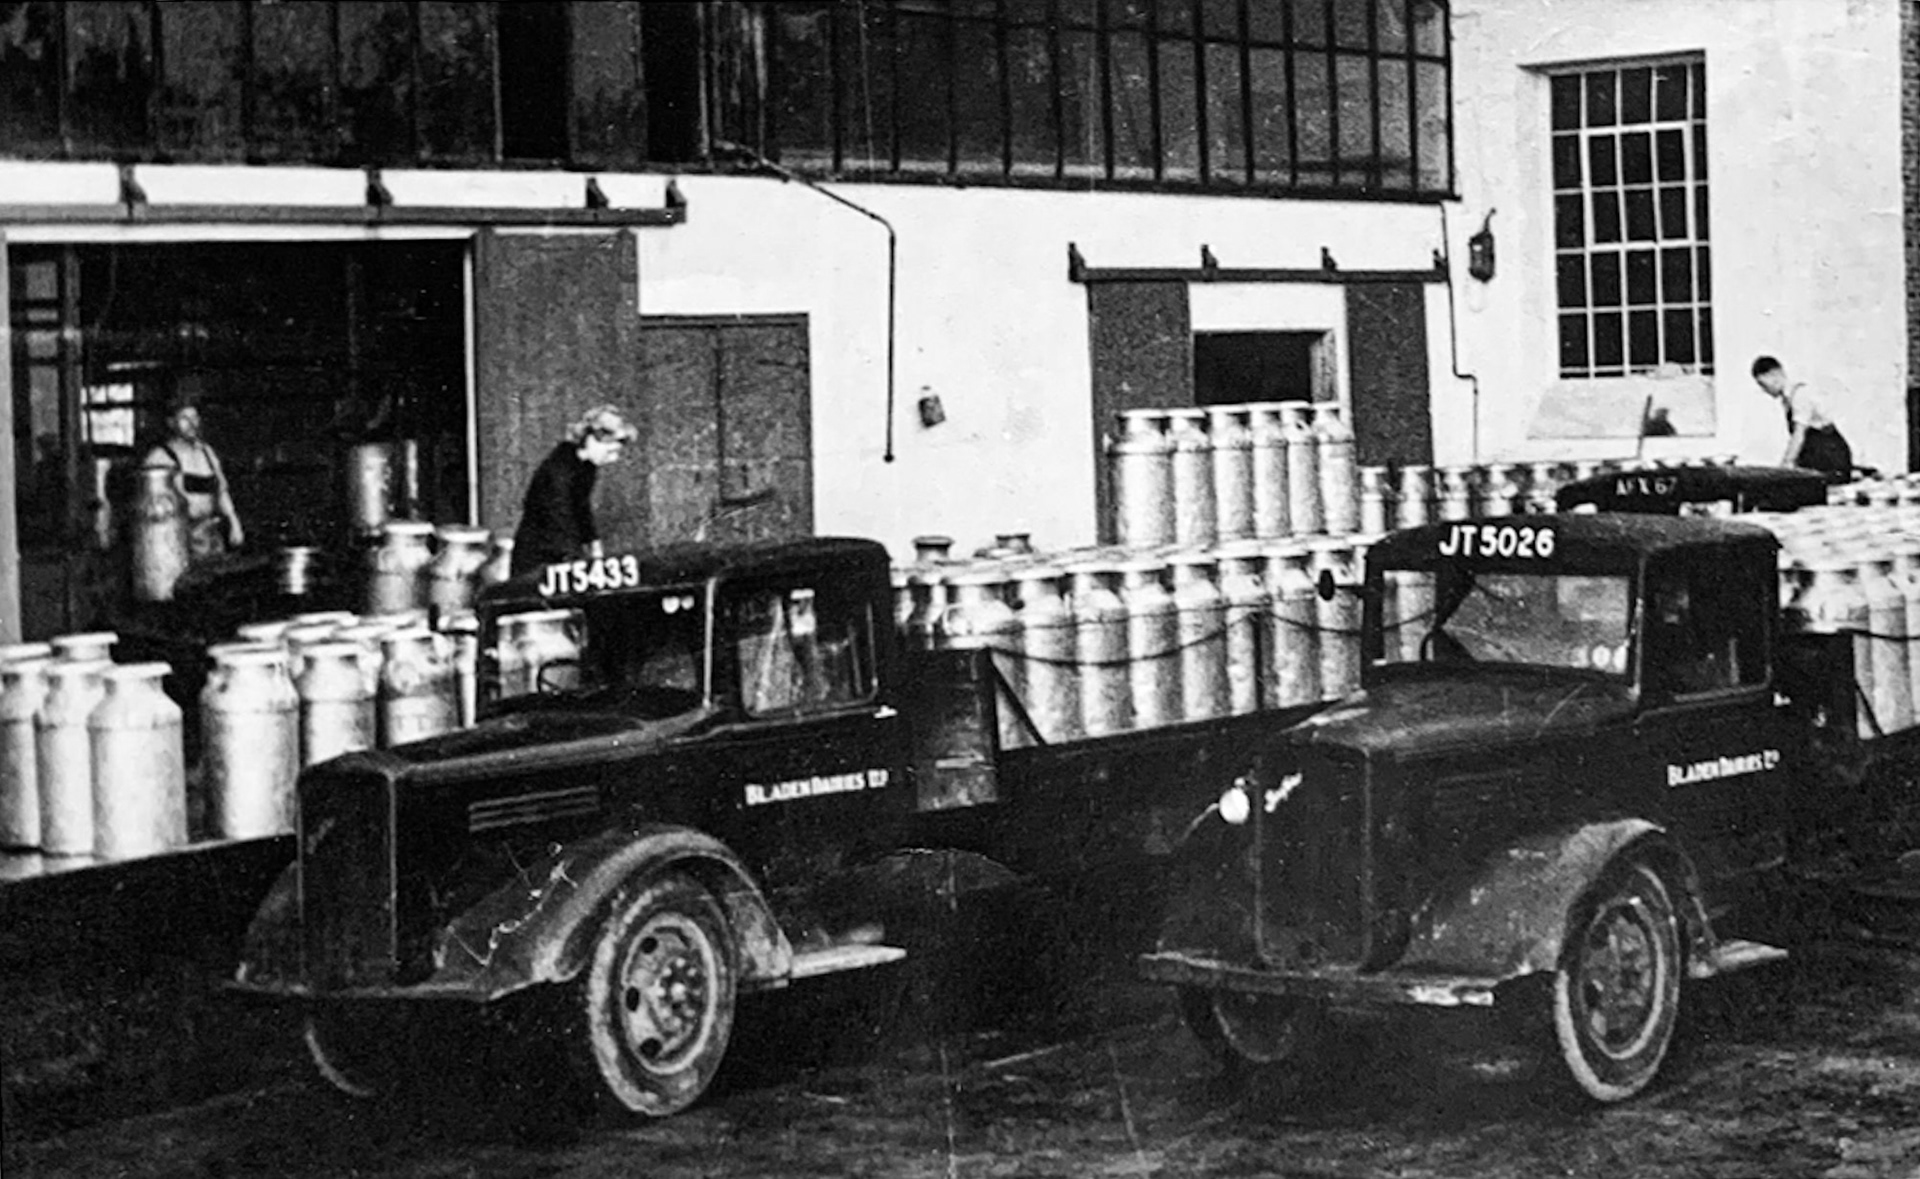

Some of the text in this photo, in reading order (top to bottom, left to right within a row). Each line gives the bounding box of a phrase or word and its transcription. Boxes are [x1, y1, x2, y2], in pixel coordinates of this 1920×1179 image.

[538, 554, 640, 596] JT5433
[744, 779, 811, 806] BLADEN
[810, 772, 866, 796] DAIRIES
[1667, 762, 1720, 787] BLADEN
